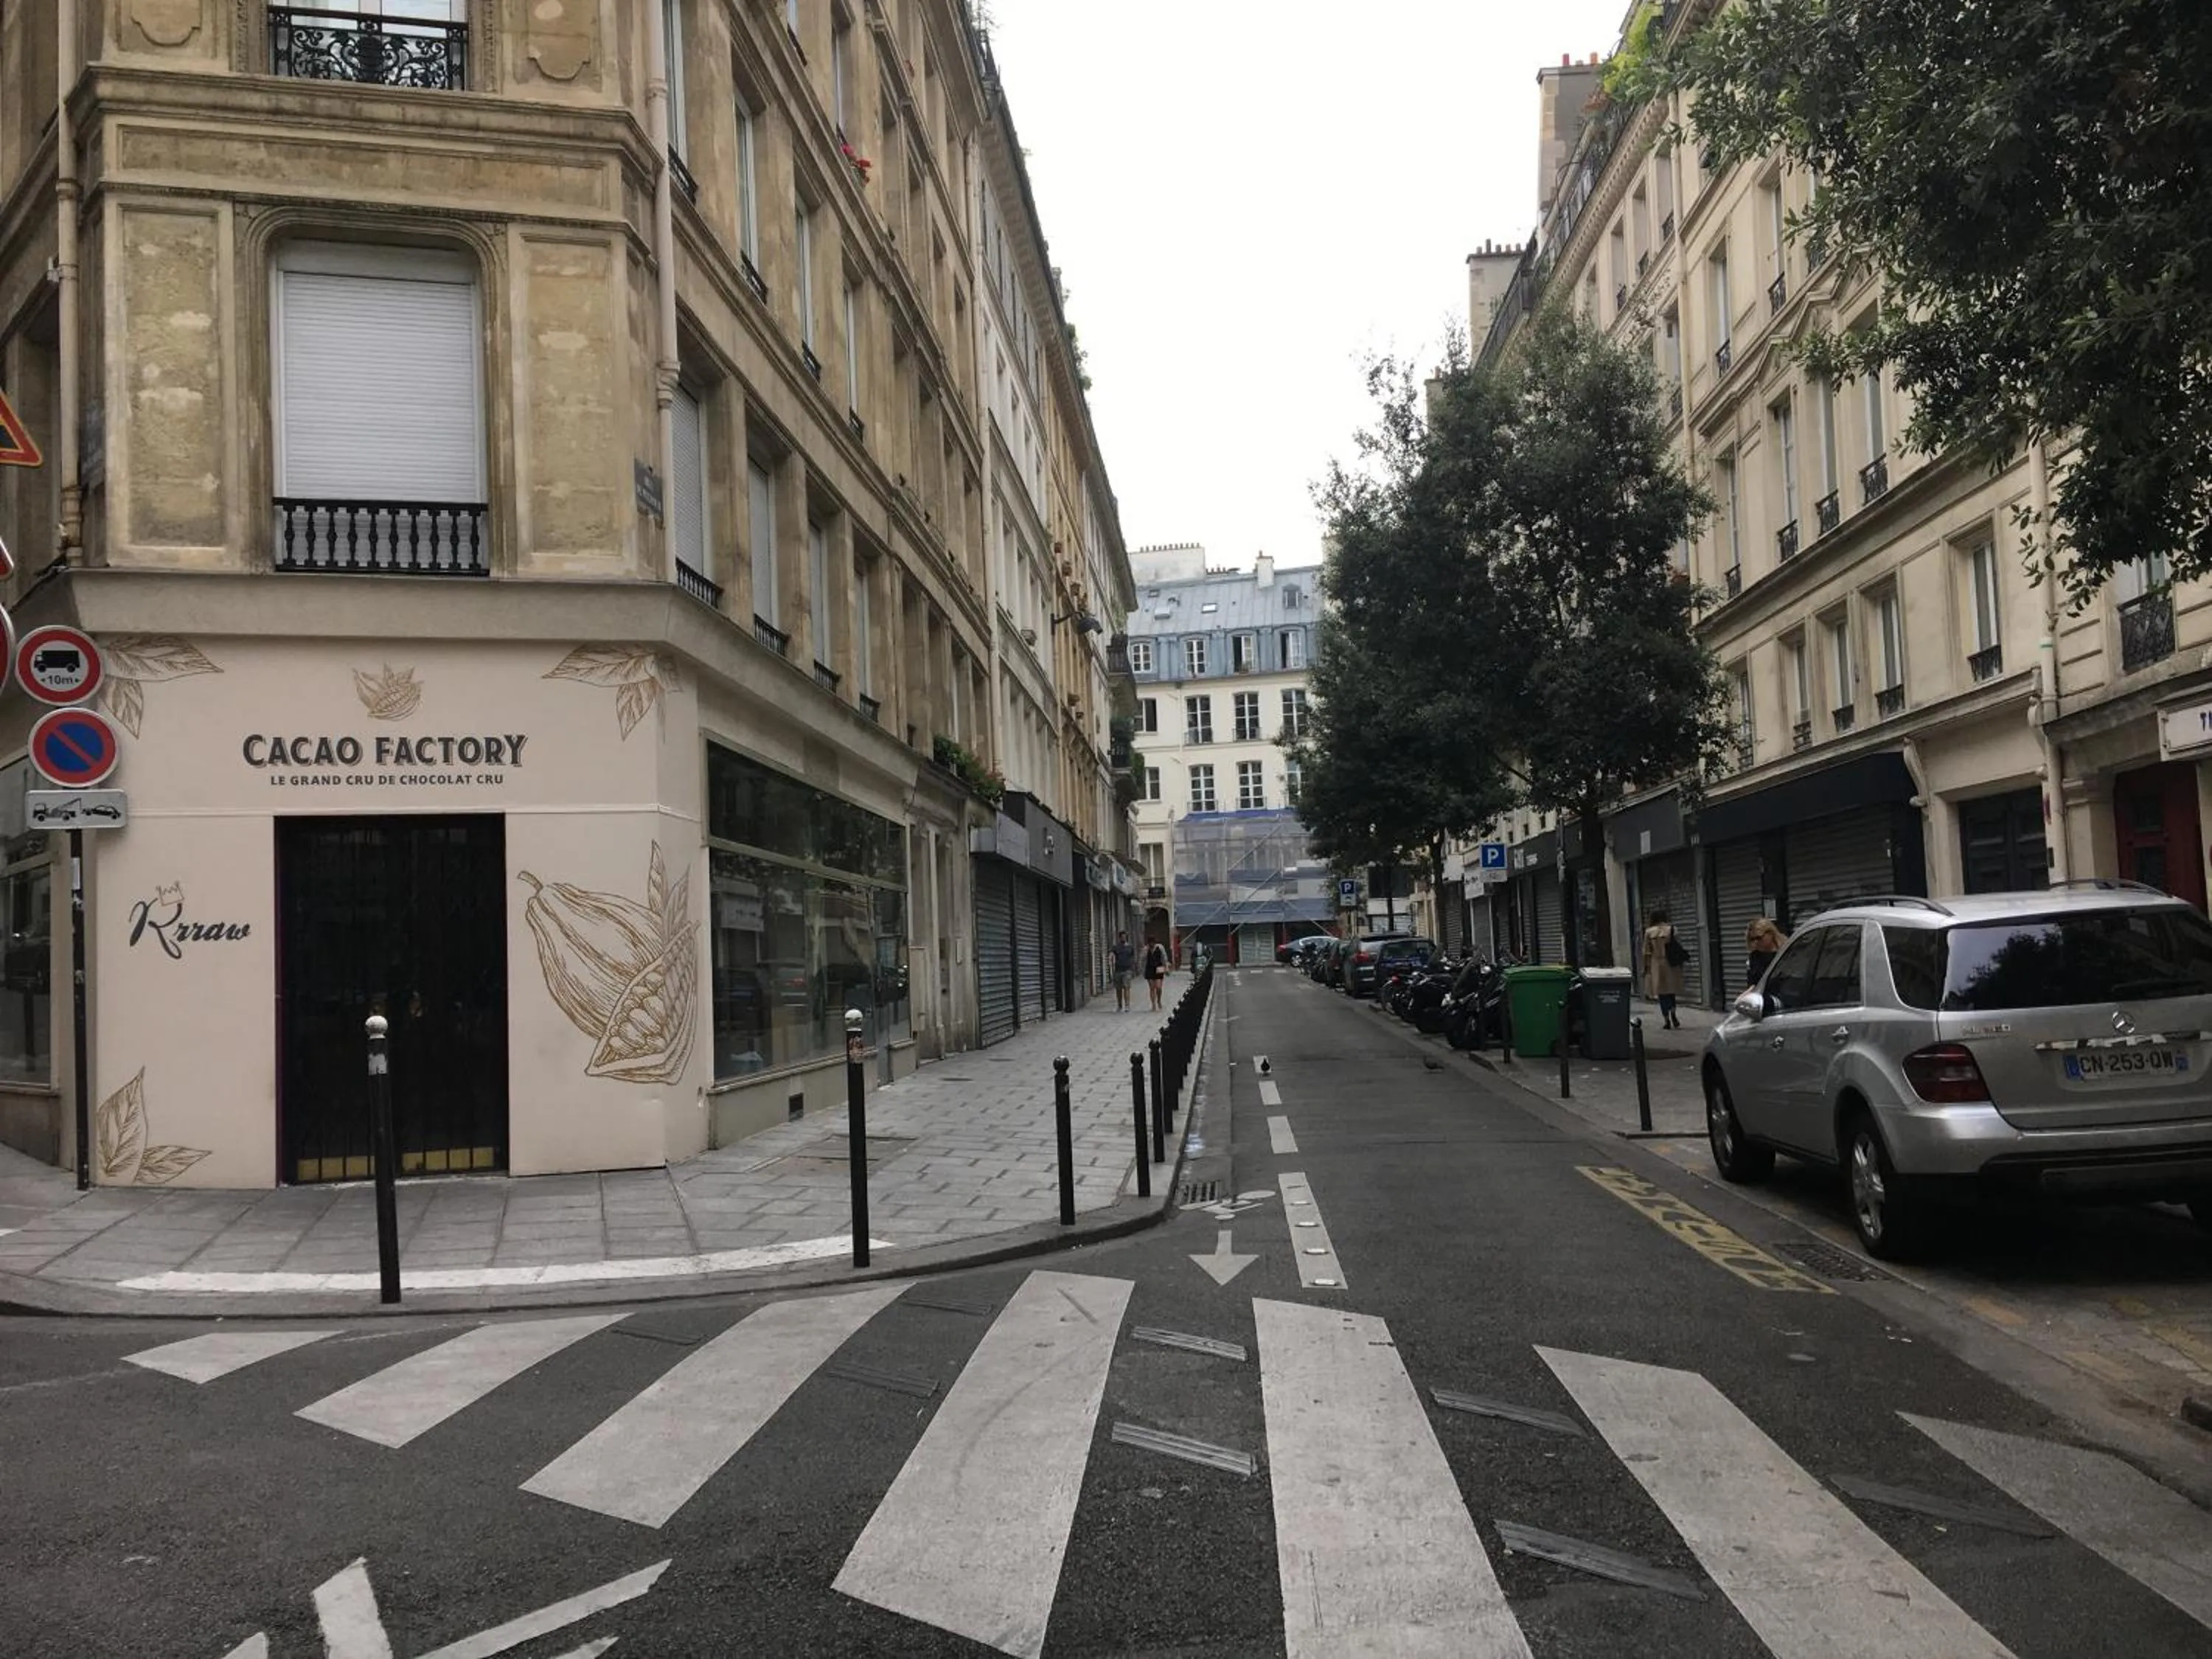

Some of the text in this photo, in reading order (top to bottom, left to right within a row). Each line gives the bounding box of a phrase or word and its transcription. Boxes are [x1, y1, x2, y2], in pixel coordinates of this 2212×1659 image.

[46, 675, 74, 685] 10m
[243, 734, 529, 768] CACAO FACTORY
[271, 774, 504, 786] LE GRAND CRU DE CHOCOLAT CRU
[1486, 848, 1500, 865] P
[129, 901, 251, 959] Rrraw
